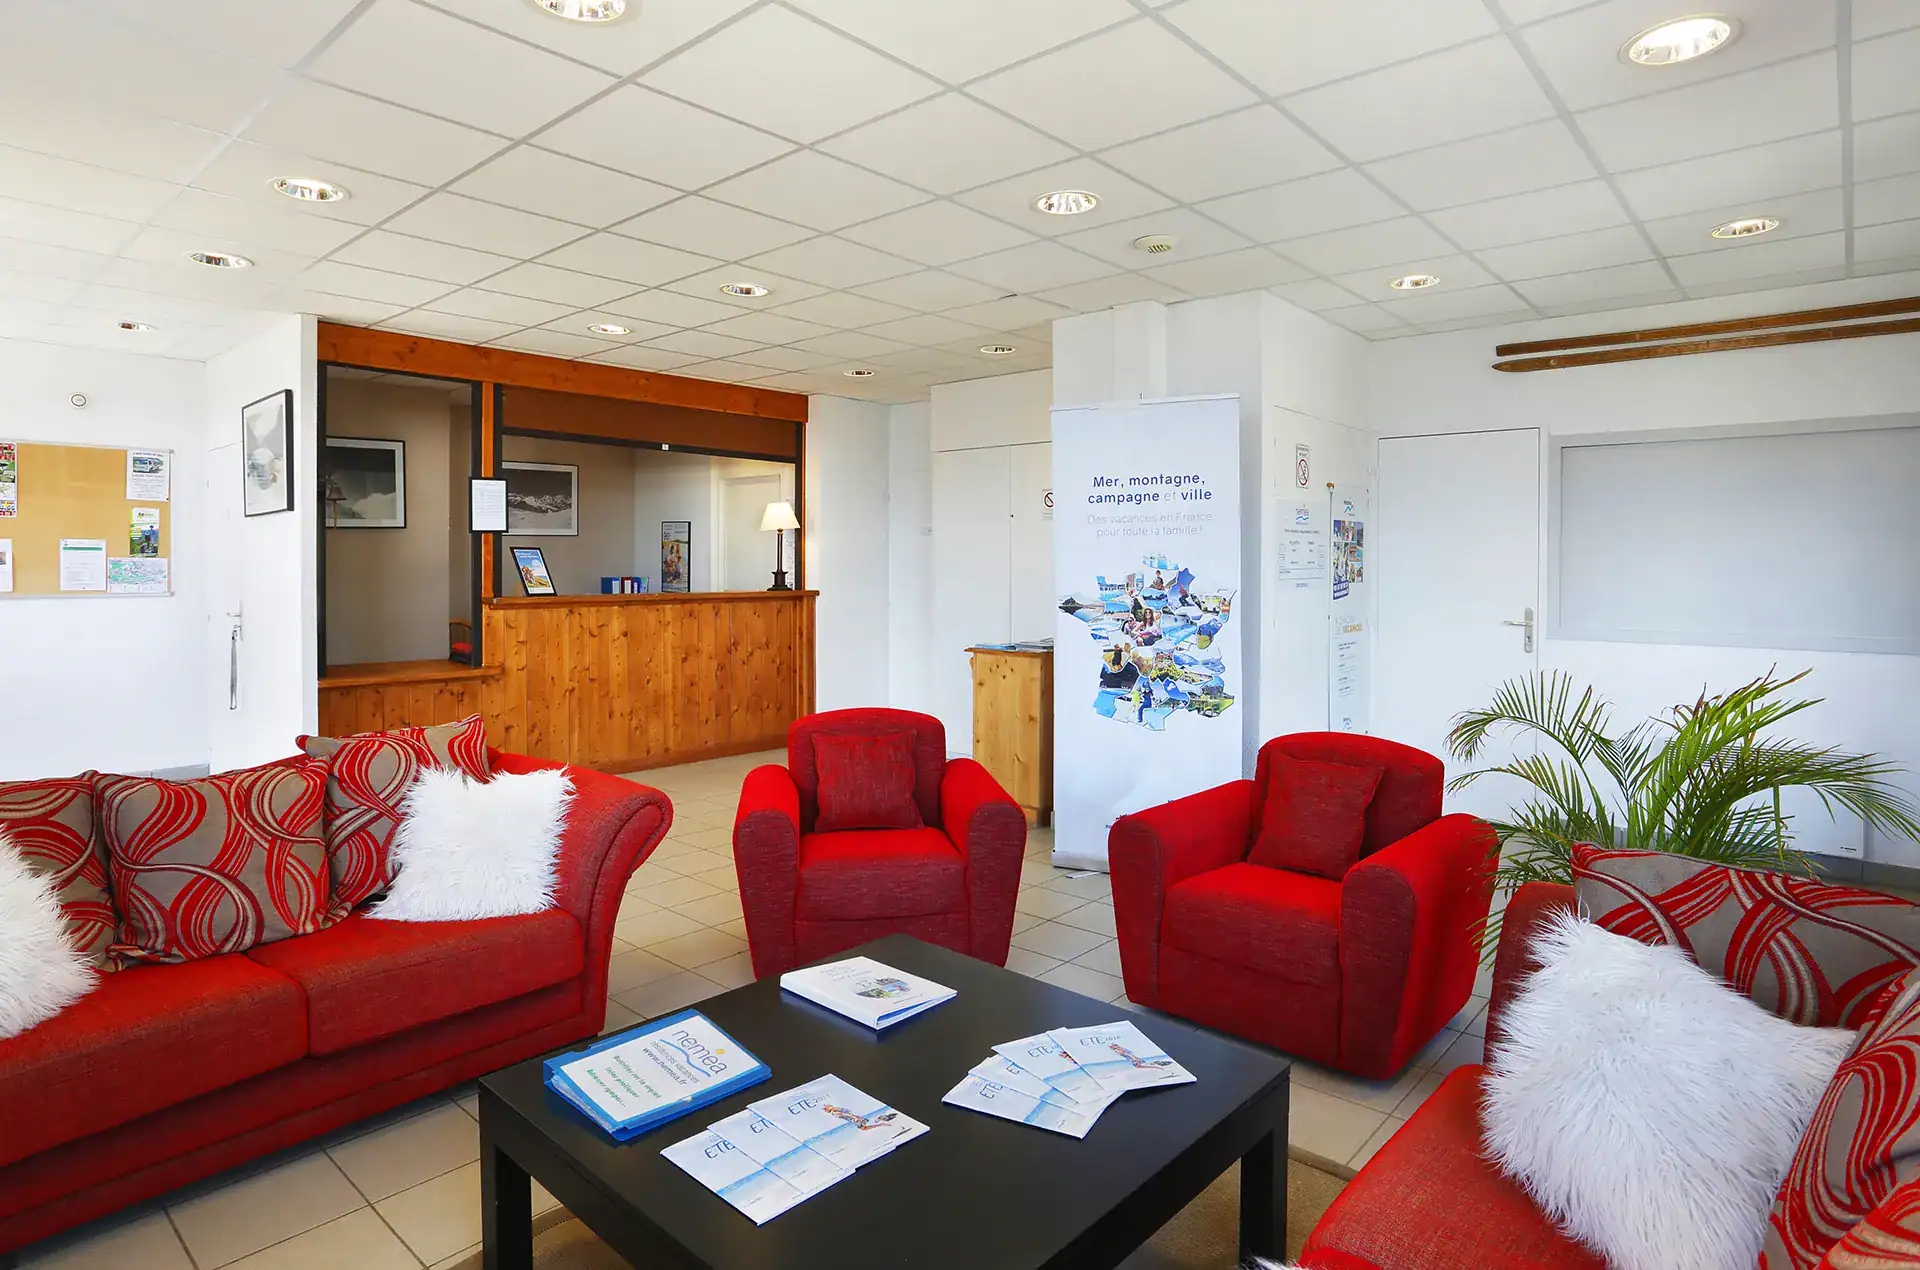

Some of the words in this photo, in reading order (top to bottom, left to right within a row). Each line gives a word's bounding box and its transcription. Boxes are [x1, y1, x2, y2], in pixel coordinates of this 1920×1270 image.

[1093, 476, 1125, 489] Mer,
[1129, 473, 1206, 488] montagne,
[1087, 491, 1160, 505] campagne
[1164, 491, 1177, 502] et
[1180, 488, 1213, 501] ville
[1087, 515, 1107, 525] Des
[1110, 514, 1157, 524] vacances
[1160, 514, 1173, 523] en
[1175, 512, 1213, 523] France
[1096, 529, 1120, 538] pour
[1122, 528, 1148, 537] toute
[1151, 527, 1160, 536] la
[1162, 526, 1197, 536] famille
[672, 1030, 727, 1074] nemea
